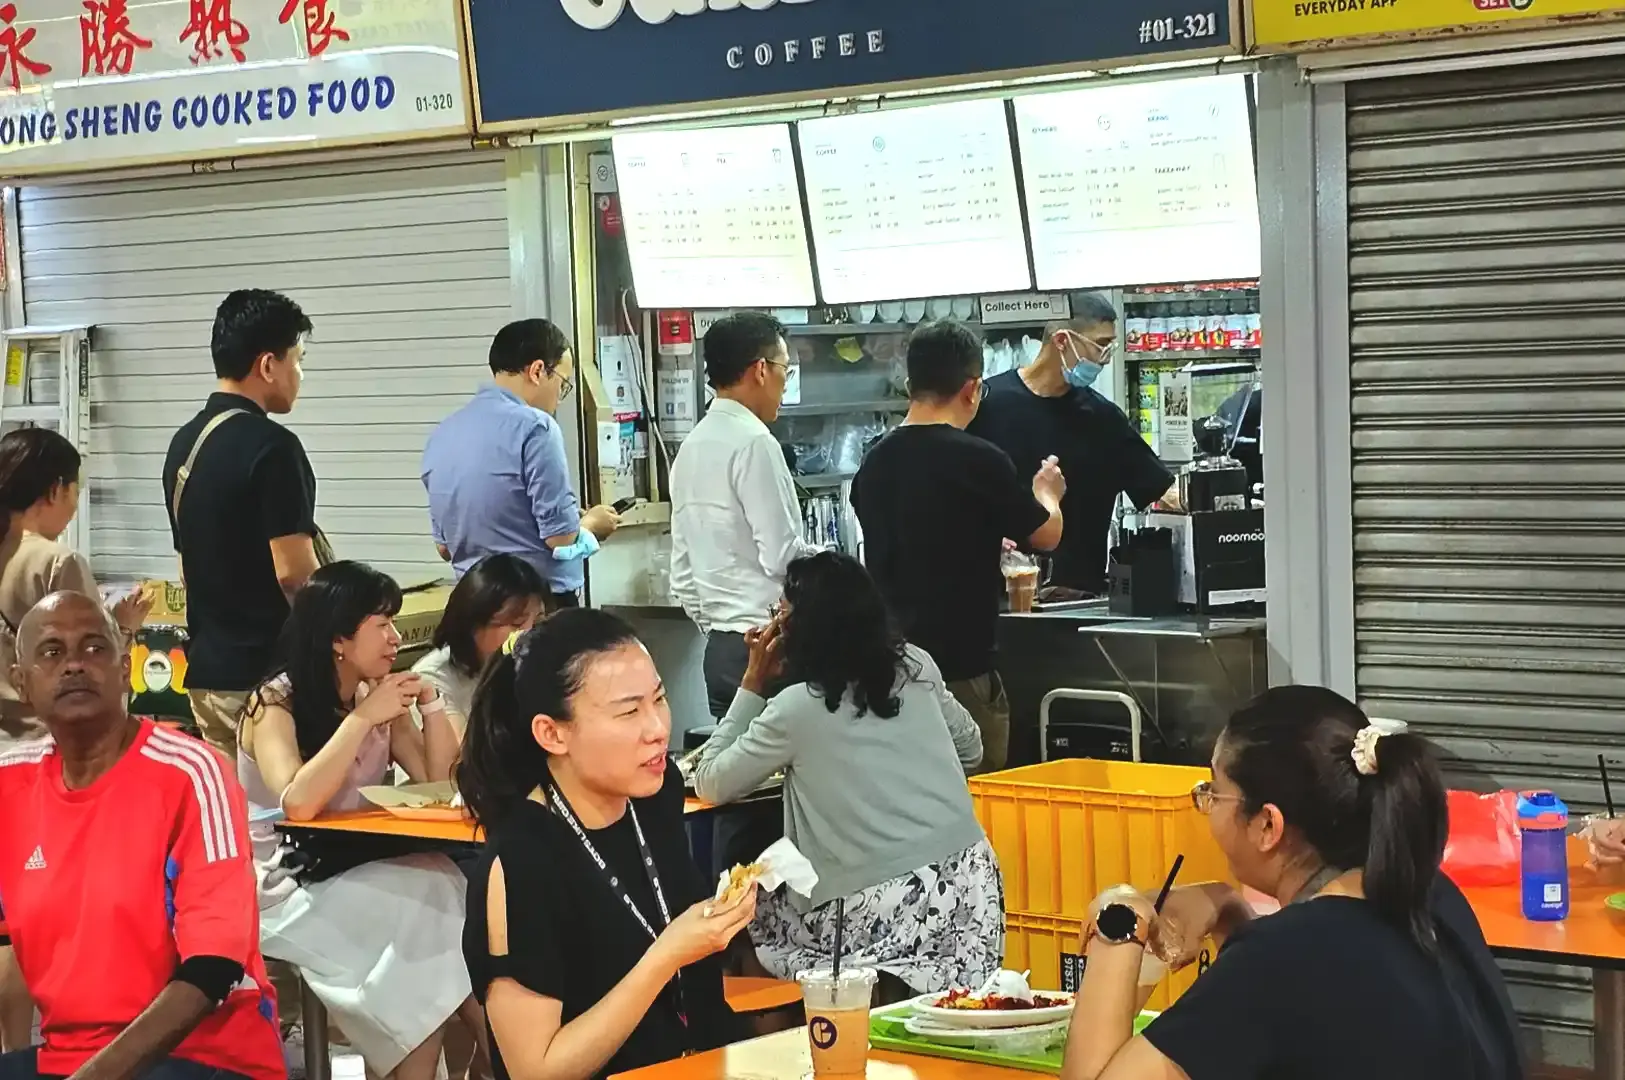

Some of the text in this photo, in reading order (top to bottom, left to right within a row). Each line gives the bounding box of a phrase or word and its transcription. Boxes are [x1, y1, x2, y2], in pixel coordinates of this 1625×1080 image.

[1294, 0, 1366, 17] EVERYDAY
[1139, 11, 1217, 44] #01-321
[726, 29, 885, 69] COFFEE
[64, 100, 162, 140] SHENG
[172, 86, 297, 130] COOKED
[308, 75, 396, 117] FOOD
[415, 93, 453, 112] 01-320
[985, 300, 1050, 312] Collect Here
